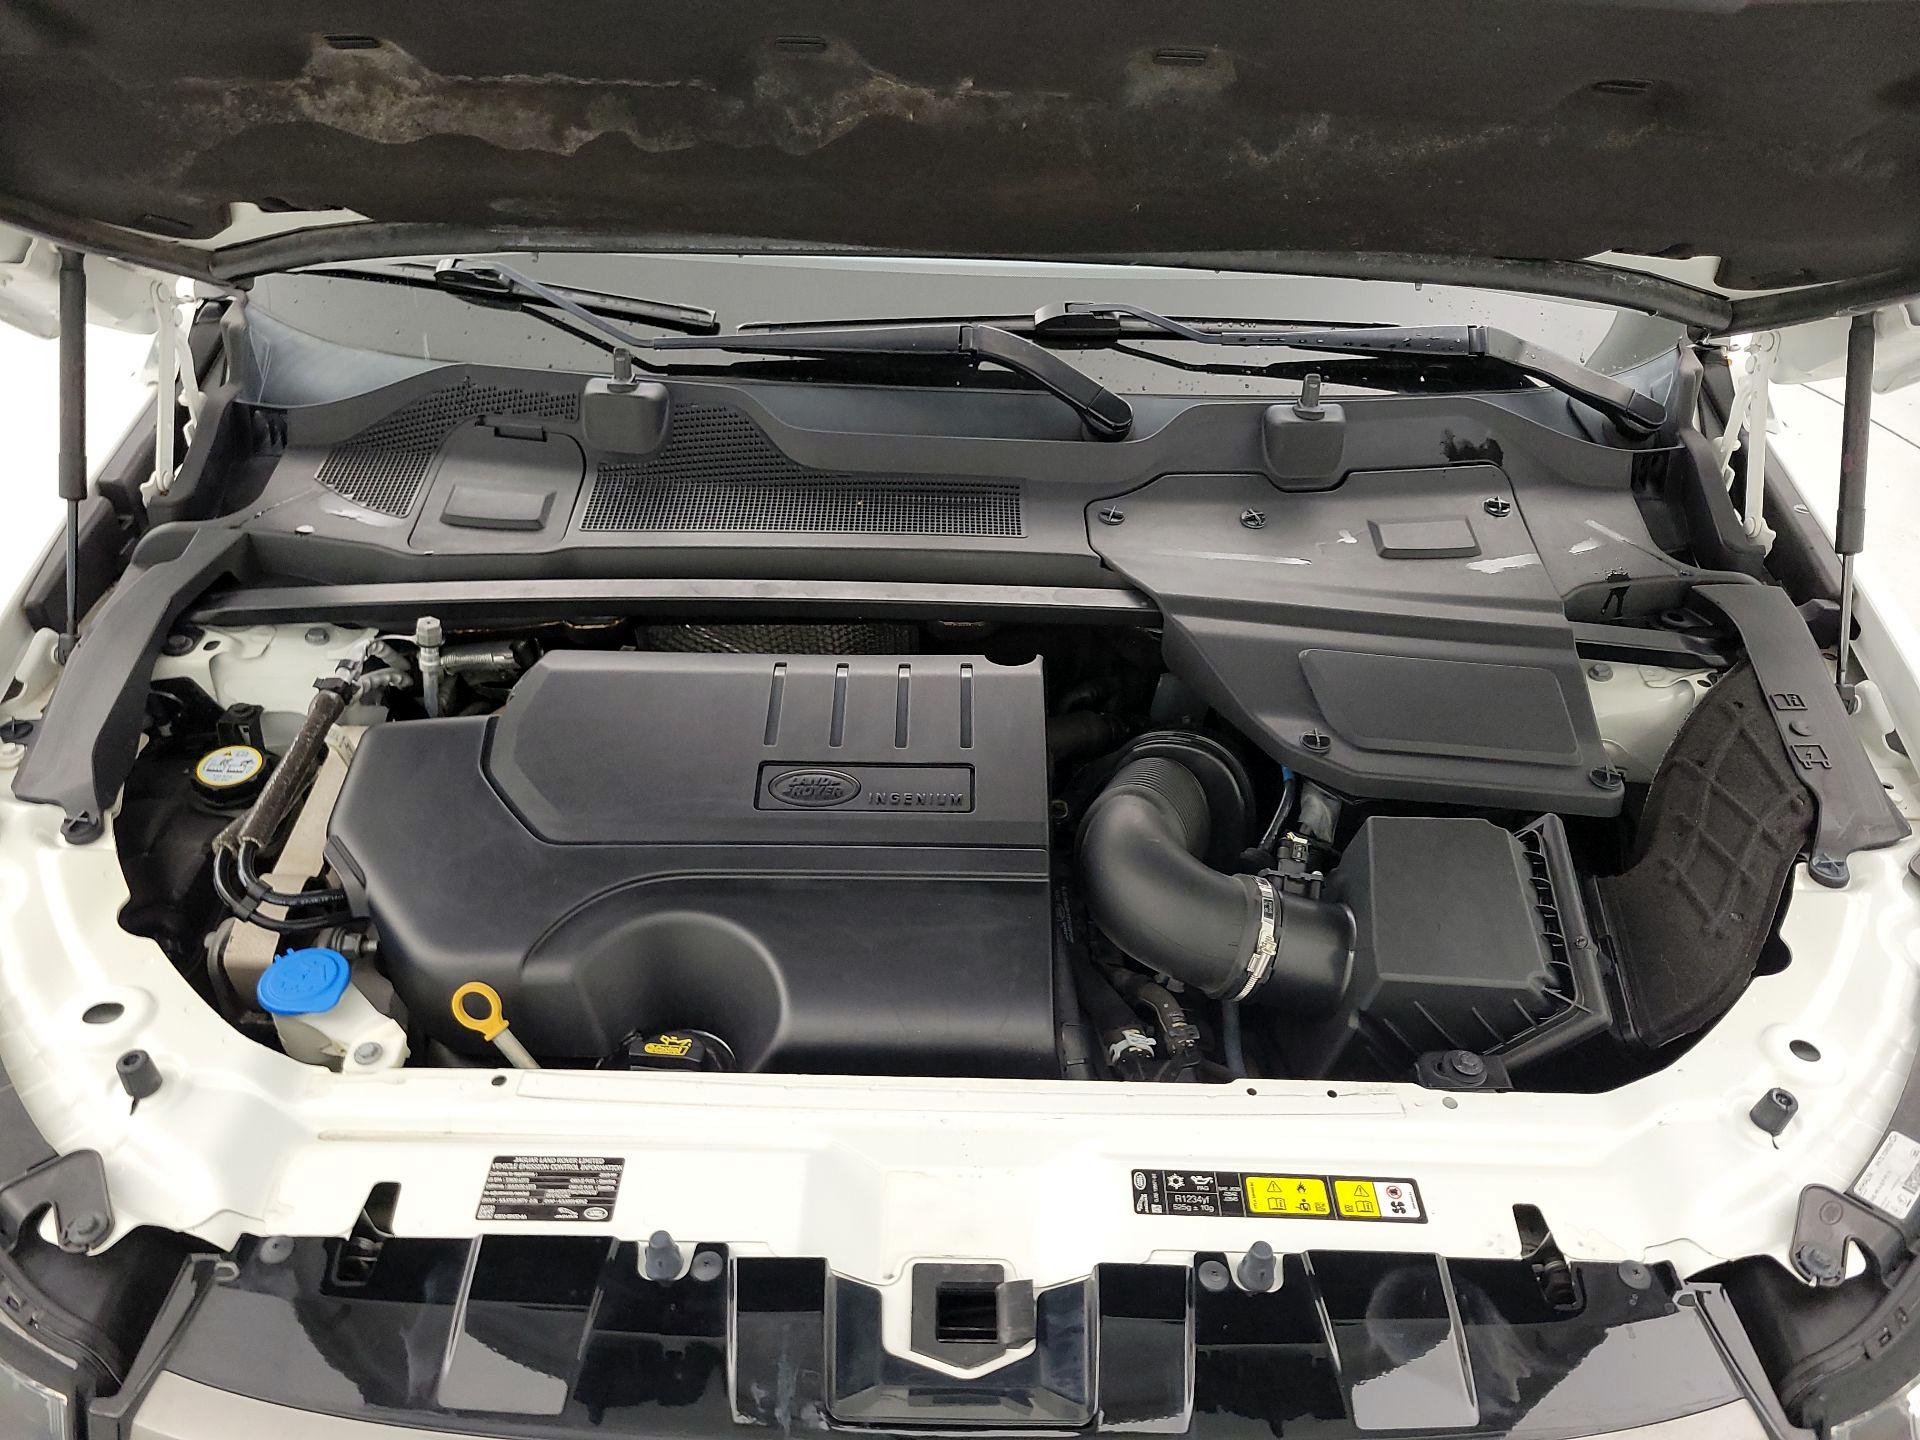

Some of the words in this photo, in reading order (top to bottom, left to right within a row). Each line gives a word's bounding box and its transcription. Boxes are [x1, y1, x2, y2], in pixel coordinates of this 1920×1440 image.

[789, 776, 834, 787] LAND
[789, 786, 844, 799] ROVER
[868, 792, 964, 806] INGENIUM
[513, 1156, 538, 1164] JAGUAR
[578, 1157, 605, 1165] LIMITED
[492, 1162, 518, 1170] VEHICLE
[518, 1163, 549, 1171] EMISSION
[550, 1163, 579, 1171] CONTROL
[580, 1164, 623, 1172] INFORMATION
[1174, 1194, 1210, 1204] R1234yf
[1172, 1203, 1192, 1211] 525g
[1200, 1204, 1215, 1213] 10g
